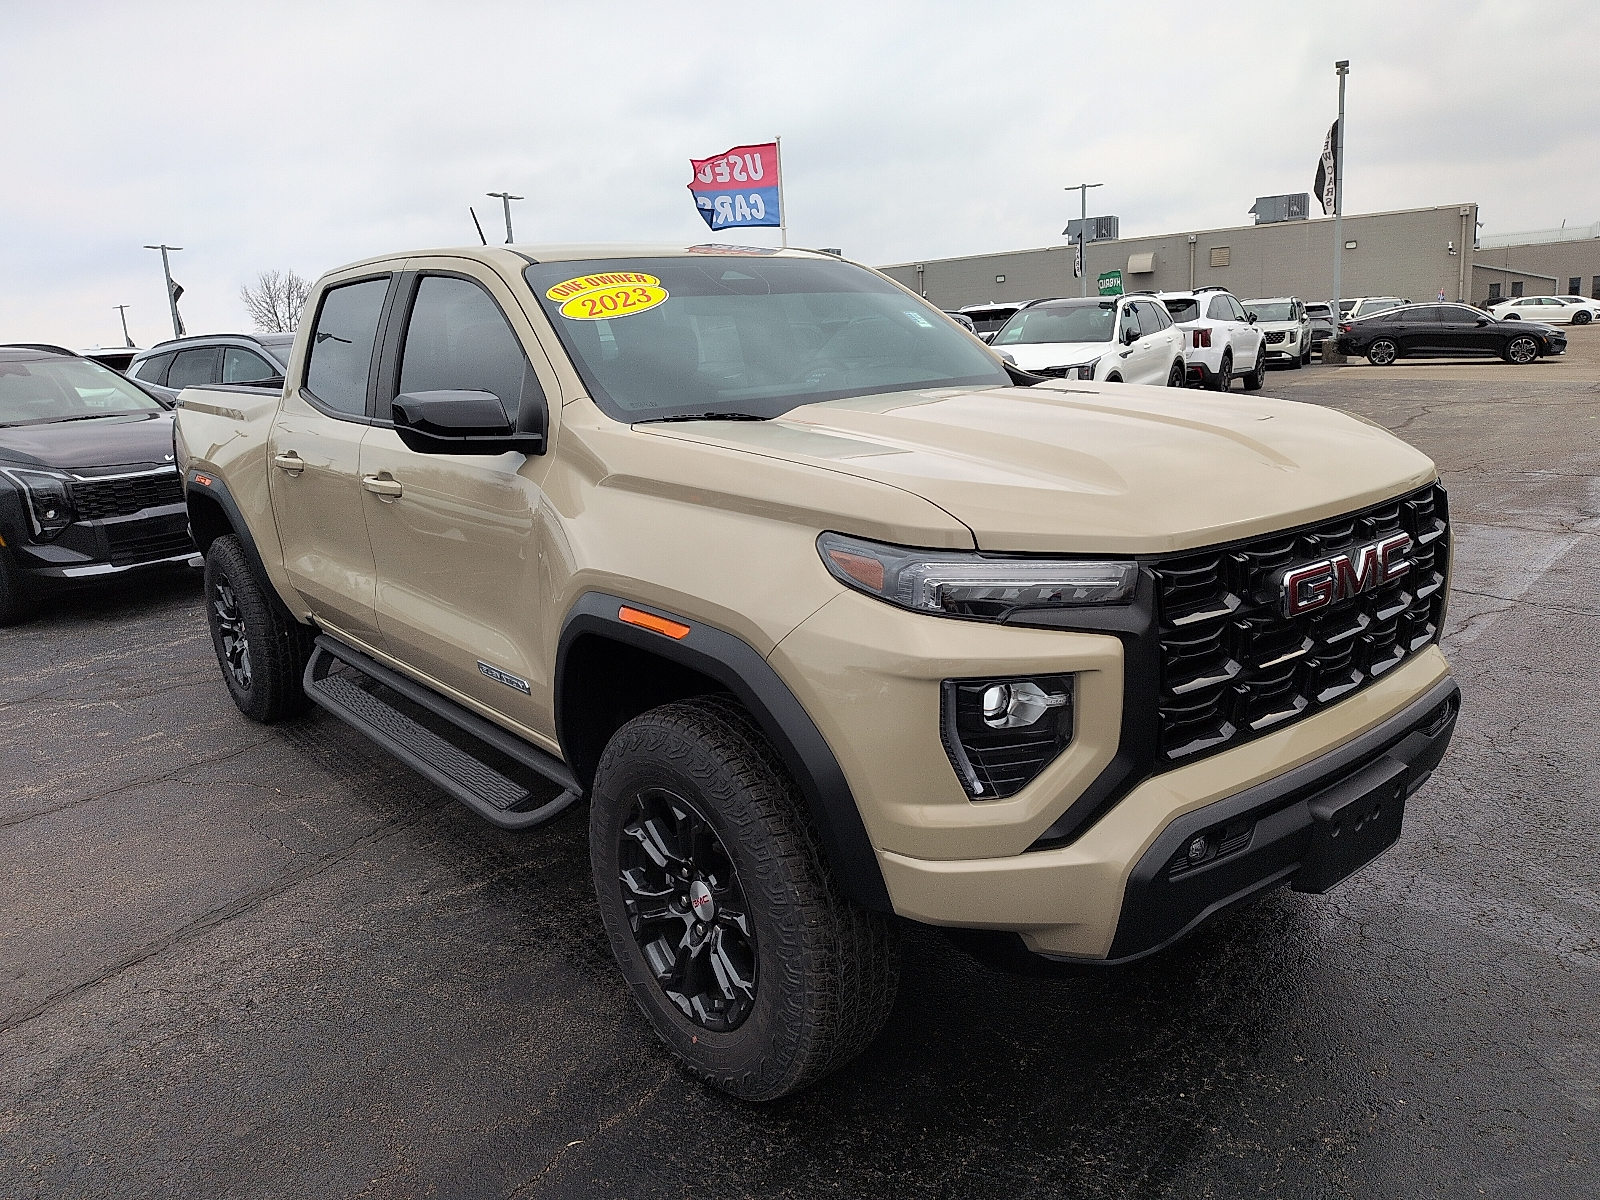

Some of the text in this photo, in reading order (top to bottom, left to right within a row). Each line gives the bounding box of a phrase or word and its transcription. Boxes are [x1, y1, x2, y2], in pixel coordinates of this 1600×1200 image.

[551, 273, 648, 298] ONE OWNER
[581, 287, 652, 317] 2023
[1281, 532, 1413, 618] GMC
[693, 895, 709, 908] GMC
